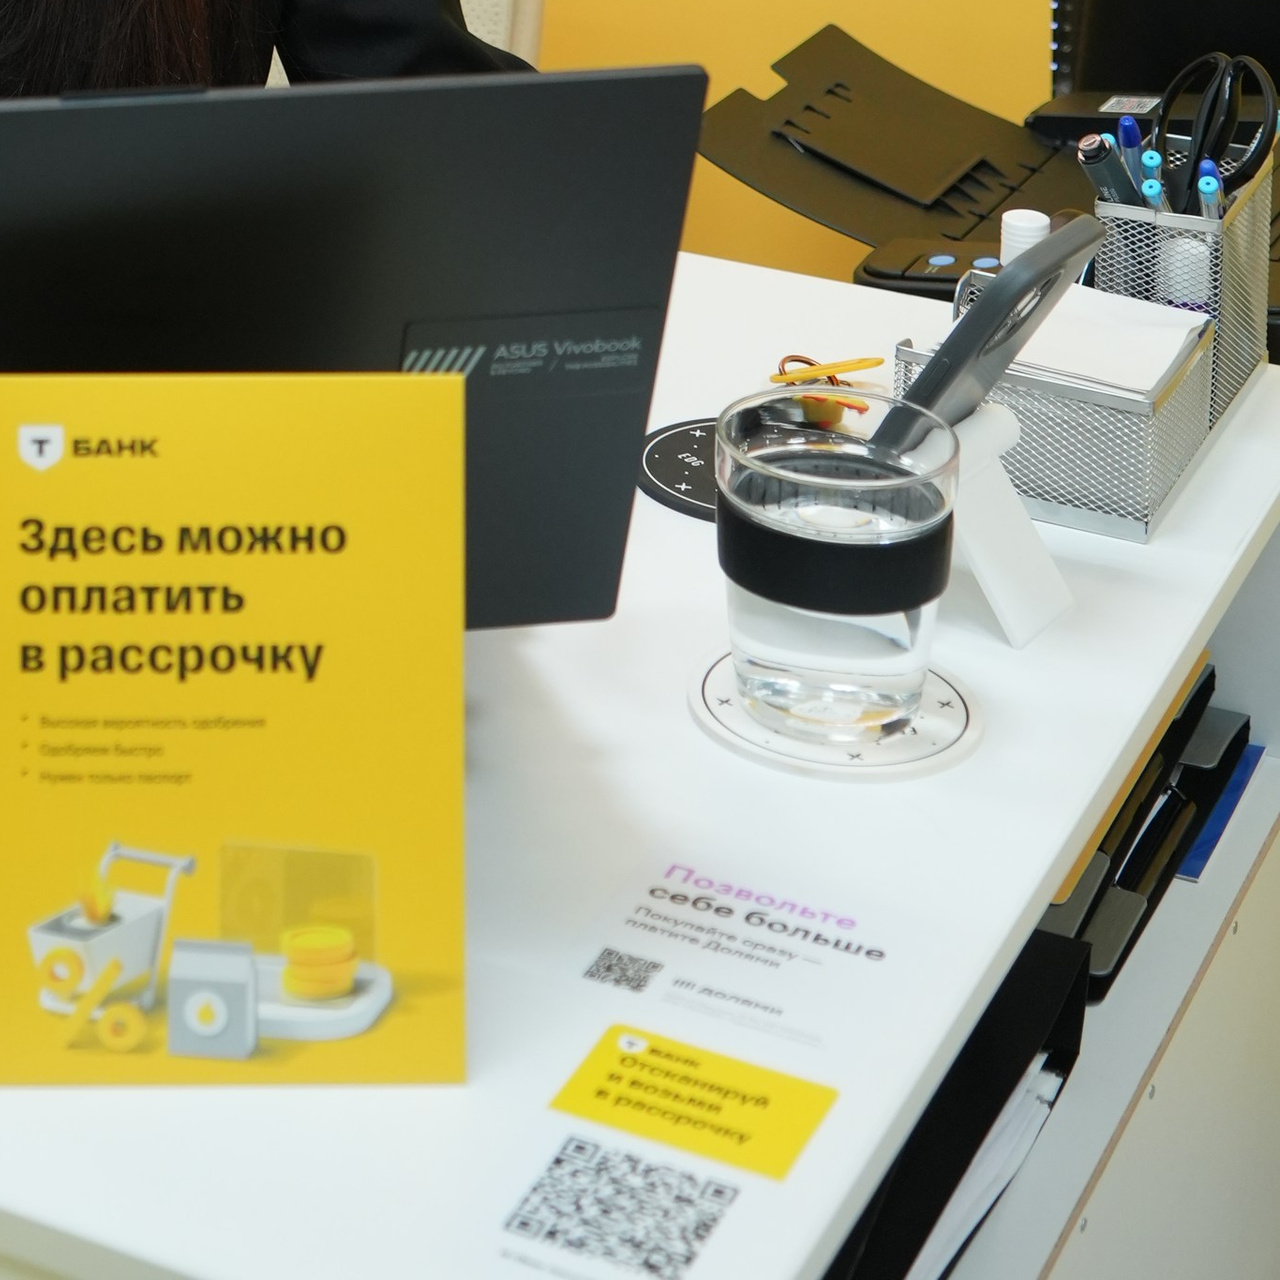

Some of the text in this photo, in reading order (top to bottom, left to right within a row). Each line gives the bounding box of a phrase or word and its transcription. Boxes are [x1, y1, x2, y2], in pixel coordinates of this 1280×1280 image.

[493, 336, 642, 361] ASUS Vivobook
[72, 438, 158, 458] БАНК
[19, 518, 348, 562] Здесь можно
[19, 583, 246, 615] оплатить
[19, 643, 325, 684] в рассрочку
[663, 864, 857, 930] Позвольте
[624, 917, 782, 970] платите Долями
[634, 905, 738, 943] Покупайте
[742, 938, 800, 961] сразу
[648, 886, 886, 961] себе больше
[606, 1071, 723, 1115] и возьми
[619, 1055, 770, 1109] Отсканируй
[595, 1088, 753, 1146] в рассрочку
